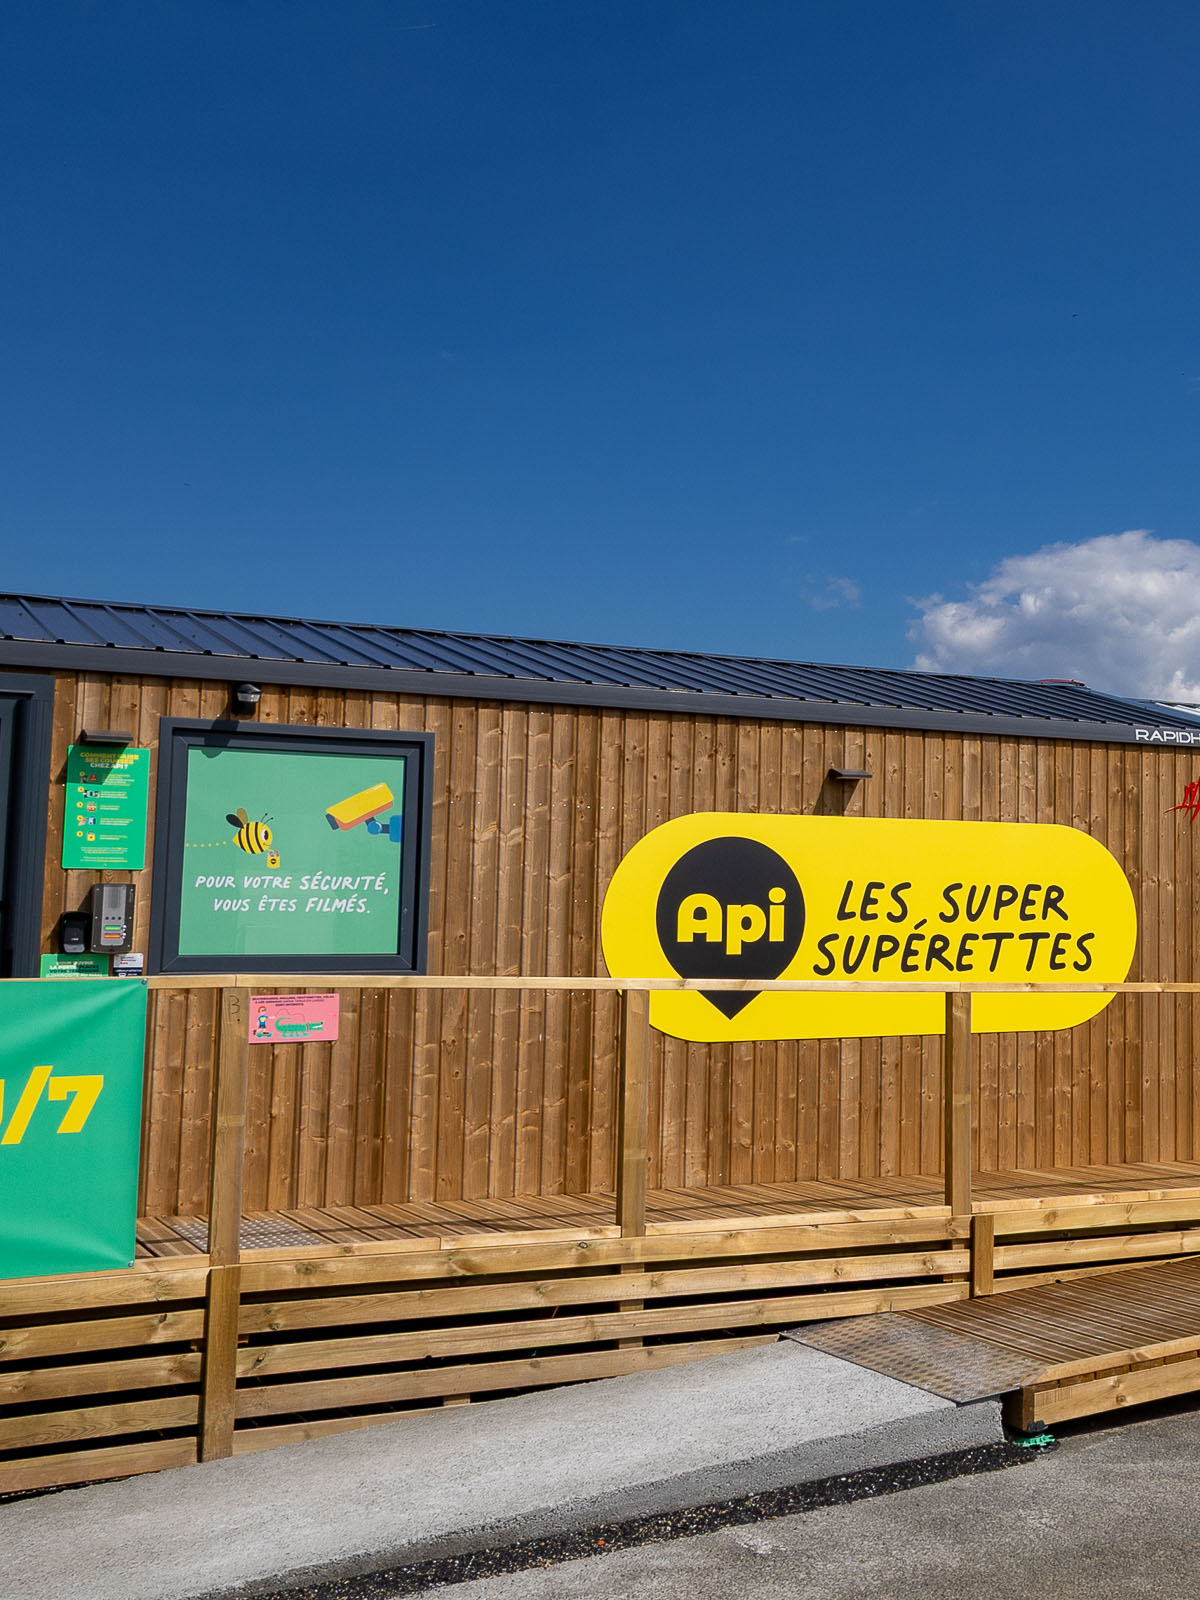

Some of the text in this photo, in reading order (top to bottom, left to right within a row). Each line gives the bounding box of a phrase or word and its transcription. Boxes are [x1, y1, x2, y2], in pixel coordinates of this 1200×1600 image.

[195, 871, 389, 894] POUR VOTRE SÉCURITÉ,
[213, 893, 371, 914] VOUS ÊTES FILMÉS.
[836, 880, 1069, 922] LES SUPER
[676, 887, 786, 956] Api
[813, 919, 1096, 977] SUPÉRETTES
[0, 1065, 104, 1145] /7
